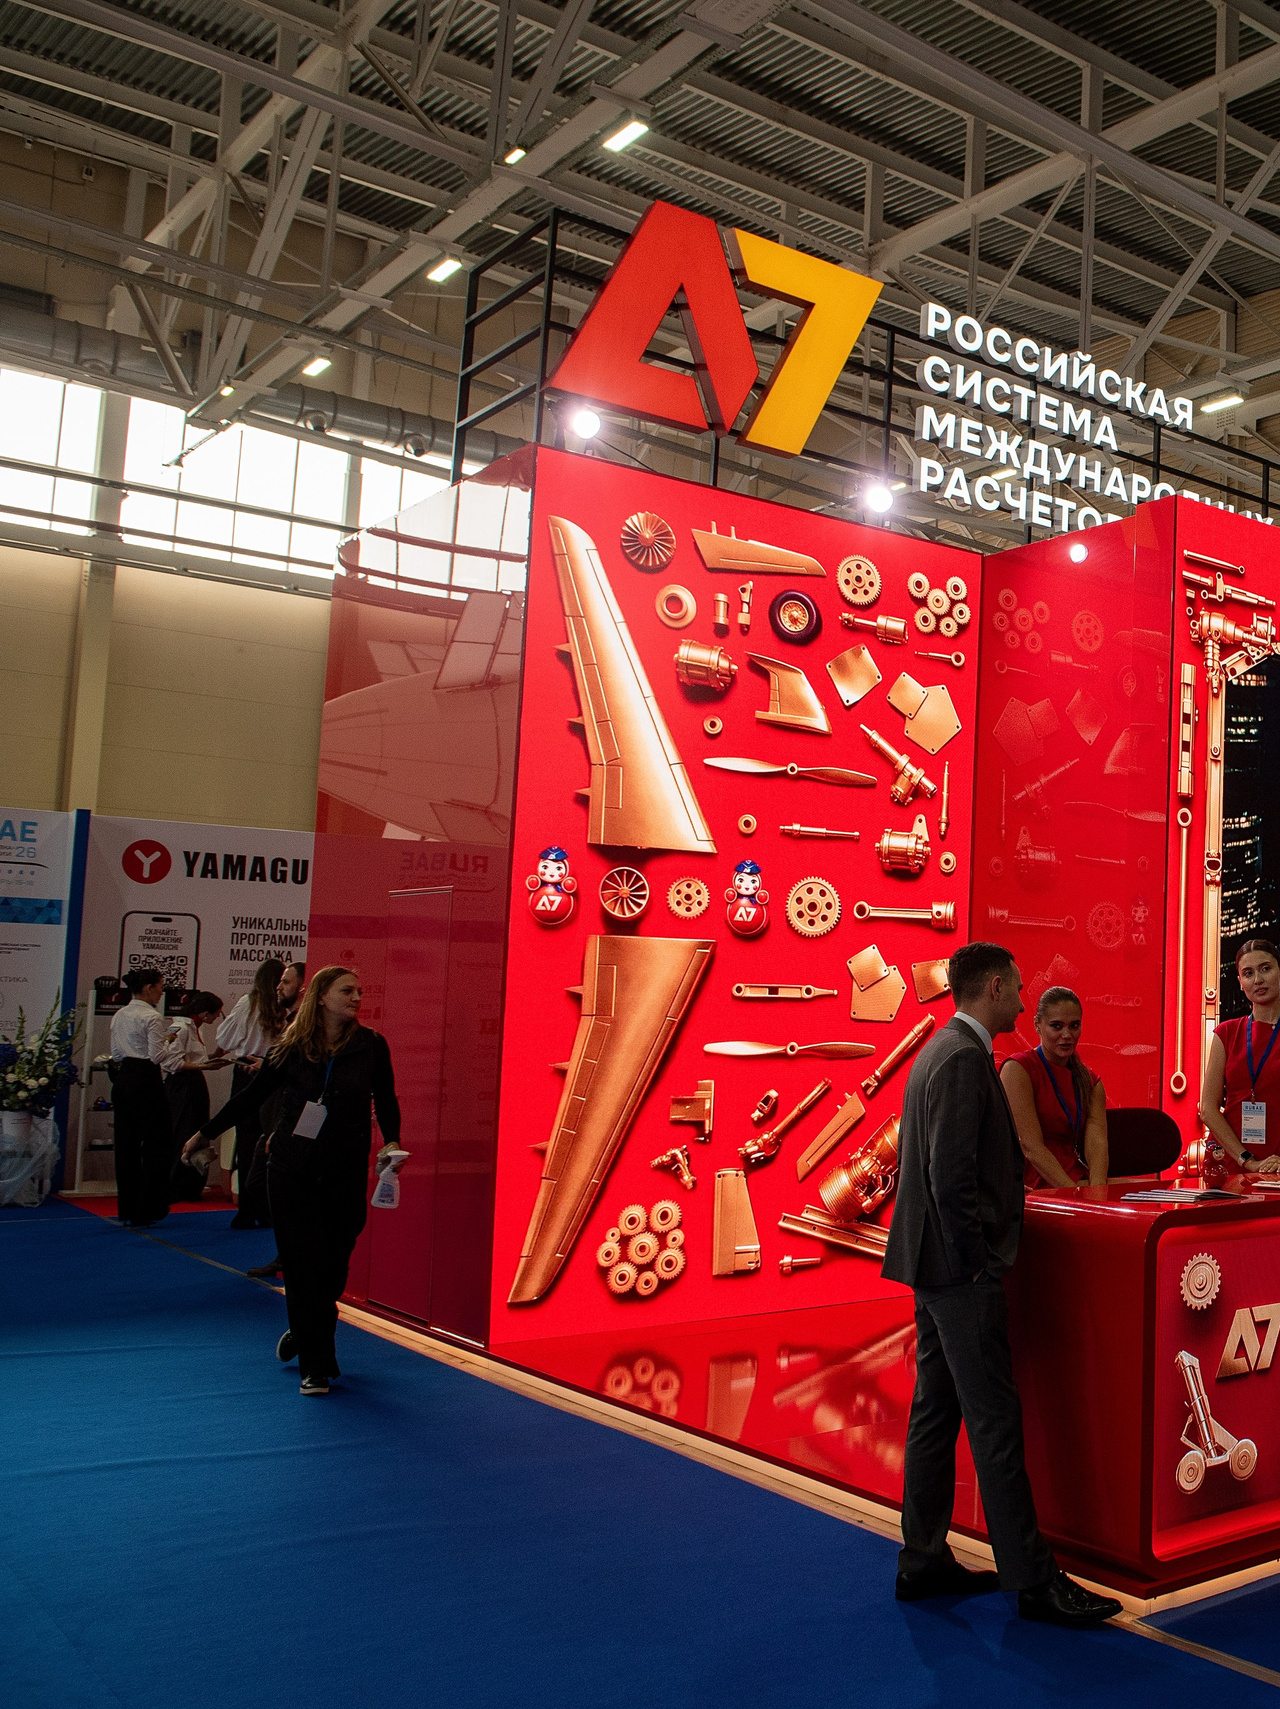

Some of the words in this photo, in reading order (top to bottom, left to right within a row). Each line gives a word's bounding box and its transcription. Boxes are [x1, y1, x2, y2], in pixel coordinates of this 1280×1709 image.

[926, 302, 1194, 431] РОССИЙСКАЯ
[923, 355, 1119, 452] СИСТЕМА
[920, 404, 1275, 526] МЕЖДУНАР
[0, 819, 38, 843] AE
[15, 846, 36, 858] 26
[183, 850, 309, 885] YAMAGU
[144, 928, 178, 936] СКАЧАЙТЕ
[232, 916, 308, 932] УНИКАЛЬНЫ
[138, 935, 183, 944] ПРИЛОЖЕНИЕ
[230, 948, 293, 963] МАССАЖА
